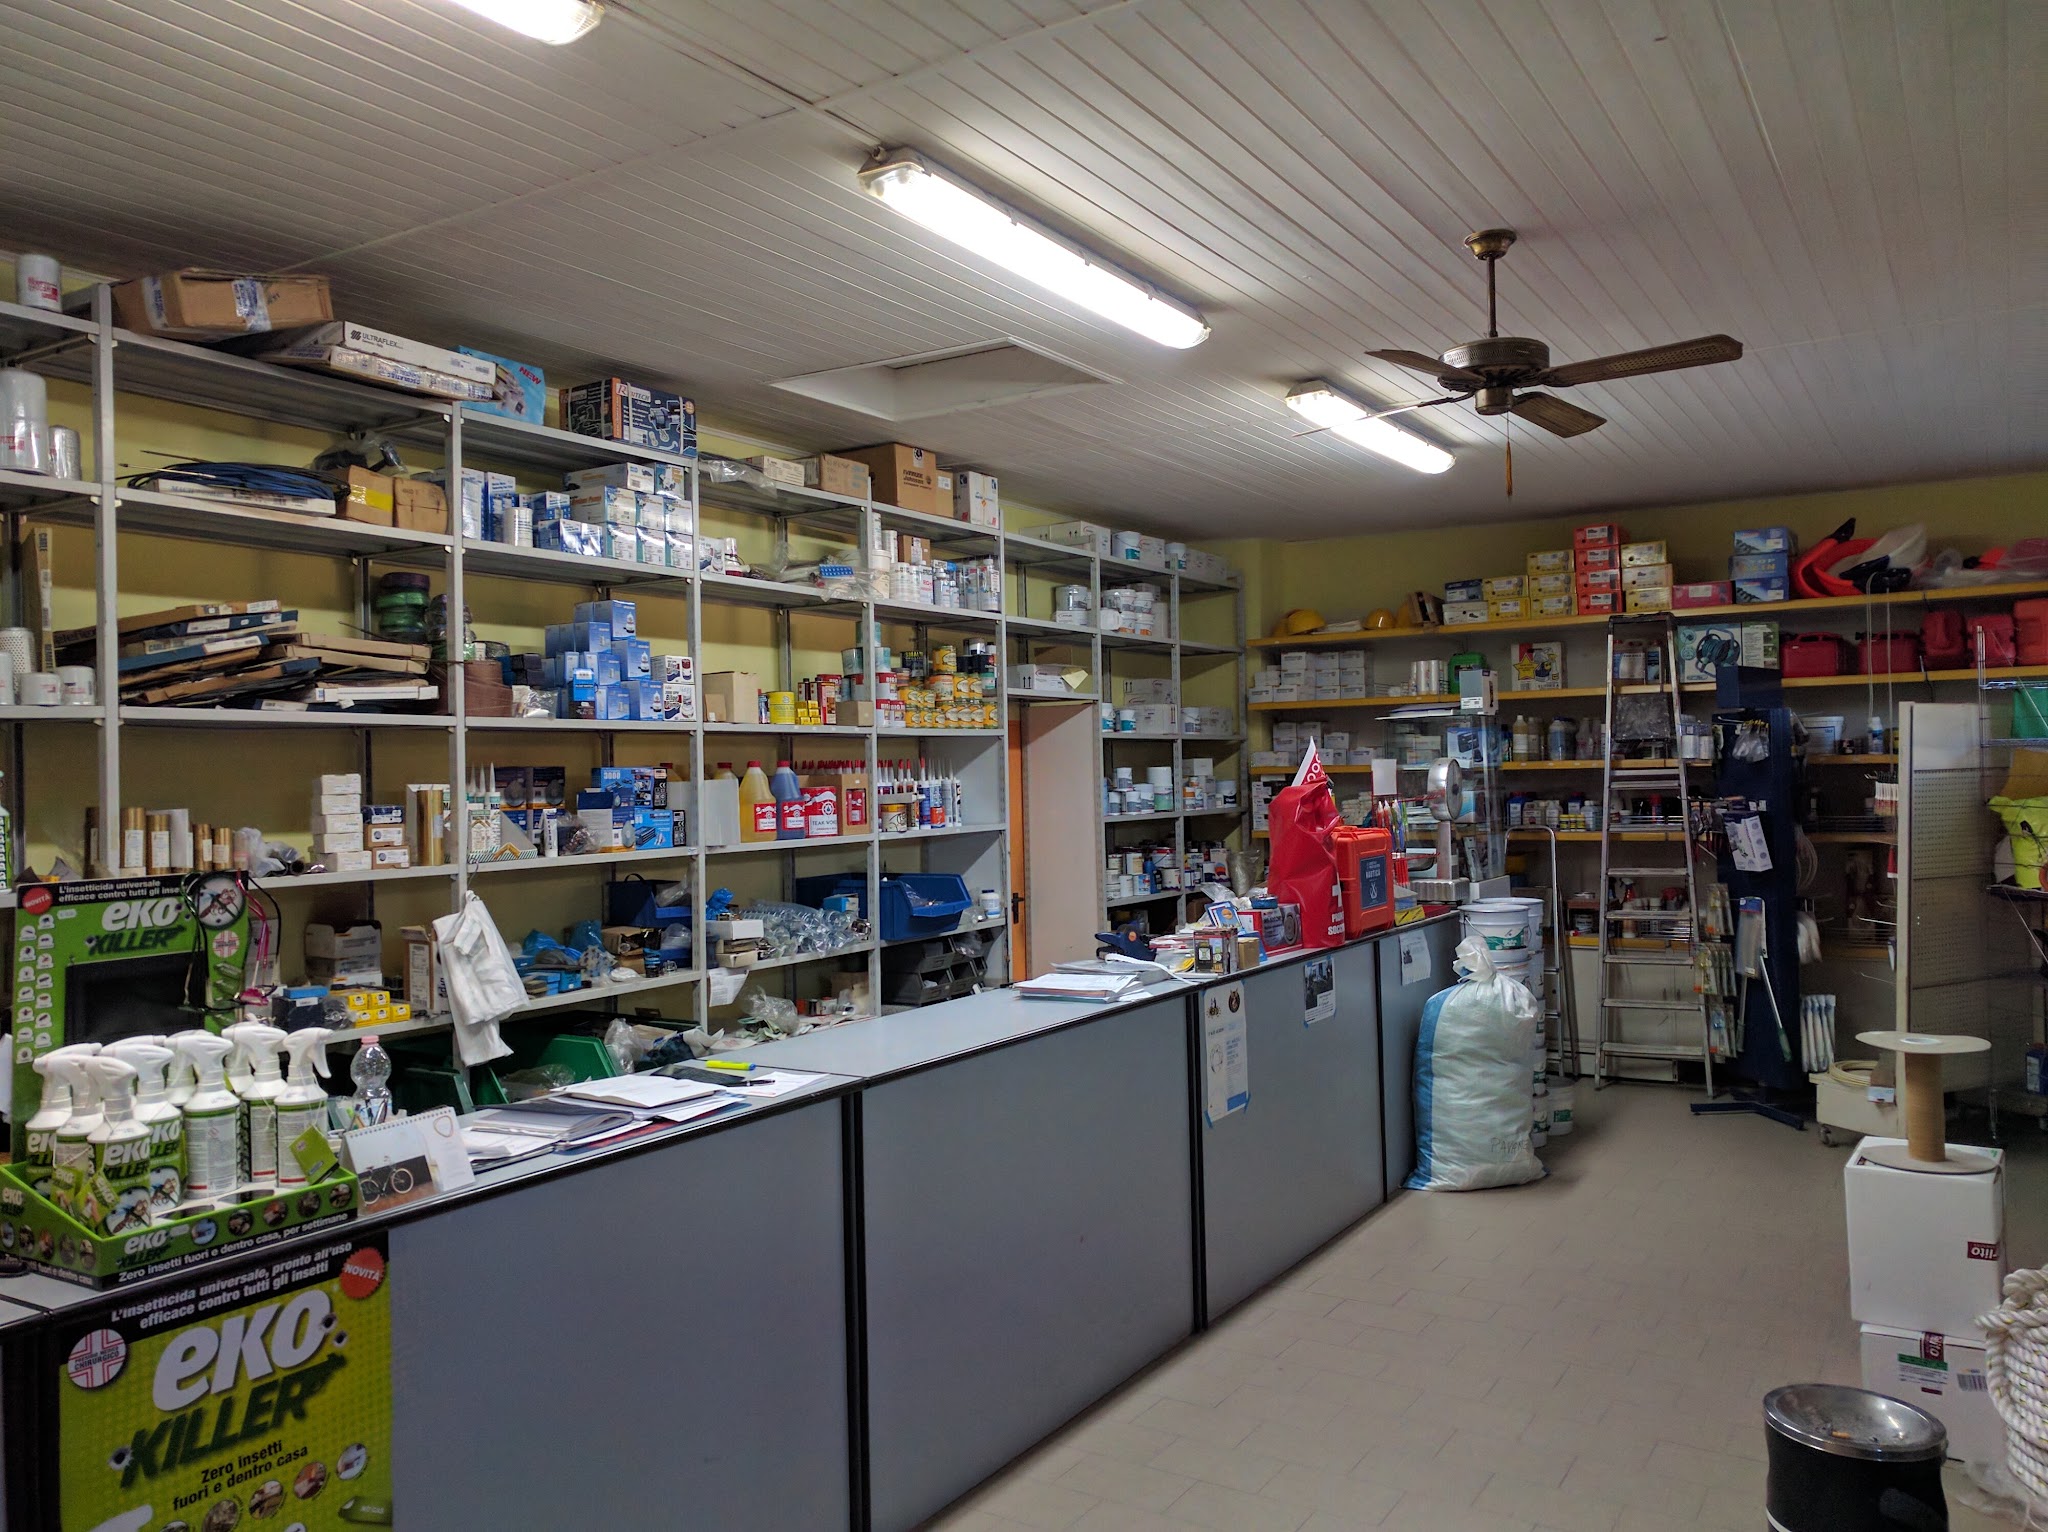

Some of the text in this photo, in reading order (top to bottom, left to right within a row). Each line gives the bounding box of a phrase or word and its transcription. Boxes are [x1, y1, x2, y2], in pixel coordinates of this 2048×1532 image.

[362, 332, 398, 347] ULTRAFLEX
[519, 366, 541, 384] NEW
[59, 879, 161, 894] L'insetticida universale
[59, 892, 96, 902] efficace
[97, 890, 126, 899] contro
[129, 887, 147, 895] tutti
[149, 886, 159, 896] gli
[25, 893, 51, 908] NOVITÀ
[88, 926, 178, 956] KILLER
[118, 1212, 348, 1282] Zero insetti fuori e dentro casa, per settimane
[111, 1242, 353, 1322] L'insetticida universale, pronto all'uso
[344, 1263, 380, 1281] NOVITÀ
[139, 1259, 329, 1329] efficace contro tutti gli insetti
[74, 1350, 120, 1371] CHIRURGICO
[75, 1346, 119, 1364] PRESIDIO MEDICO
[120, 1358, 325, 1490] KILLER
[201, 1440, 282, 1484] Zero insetti
[173, 1446, 308, 1510] fuori e dentro casa
